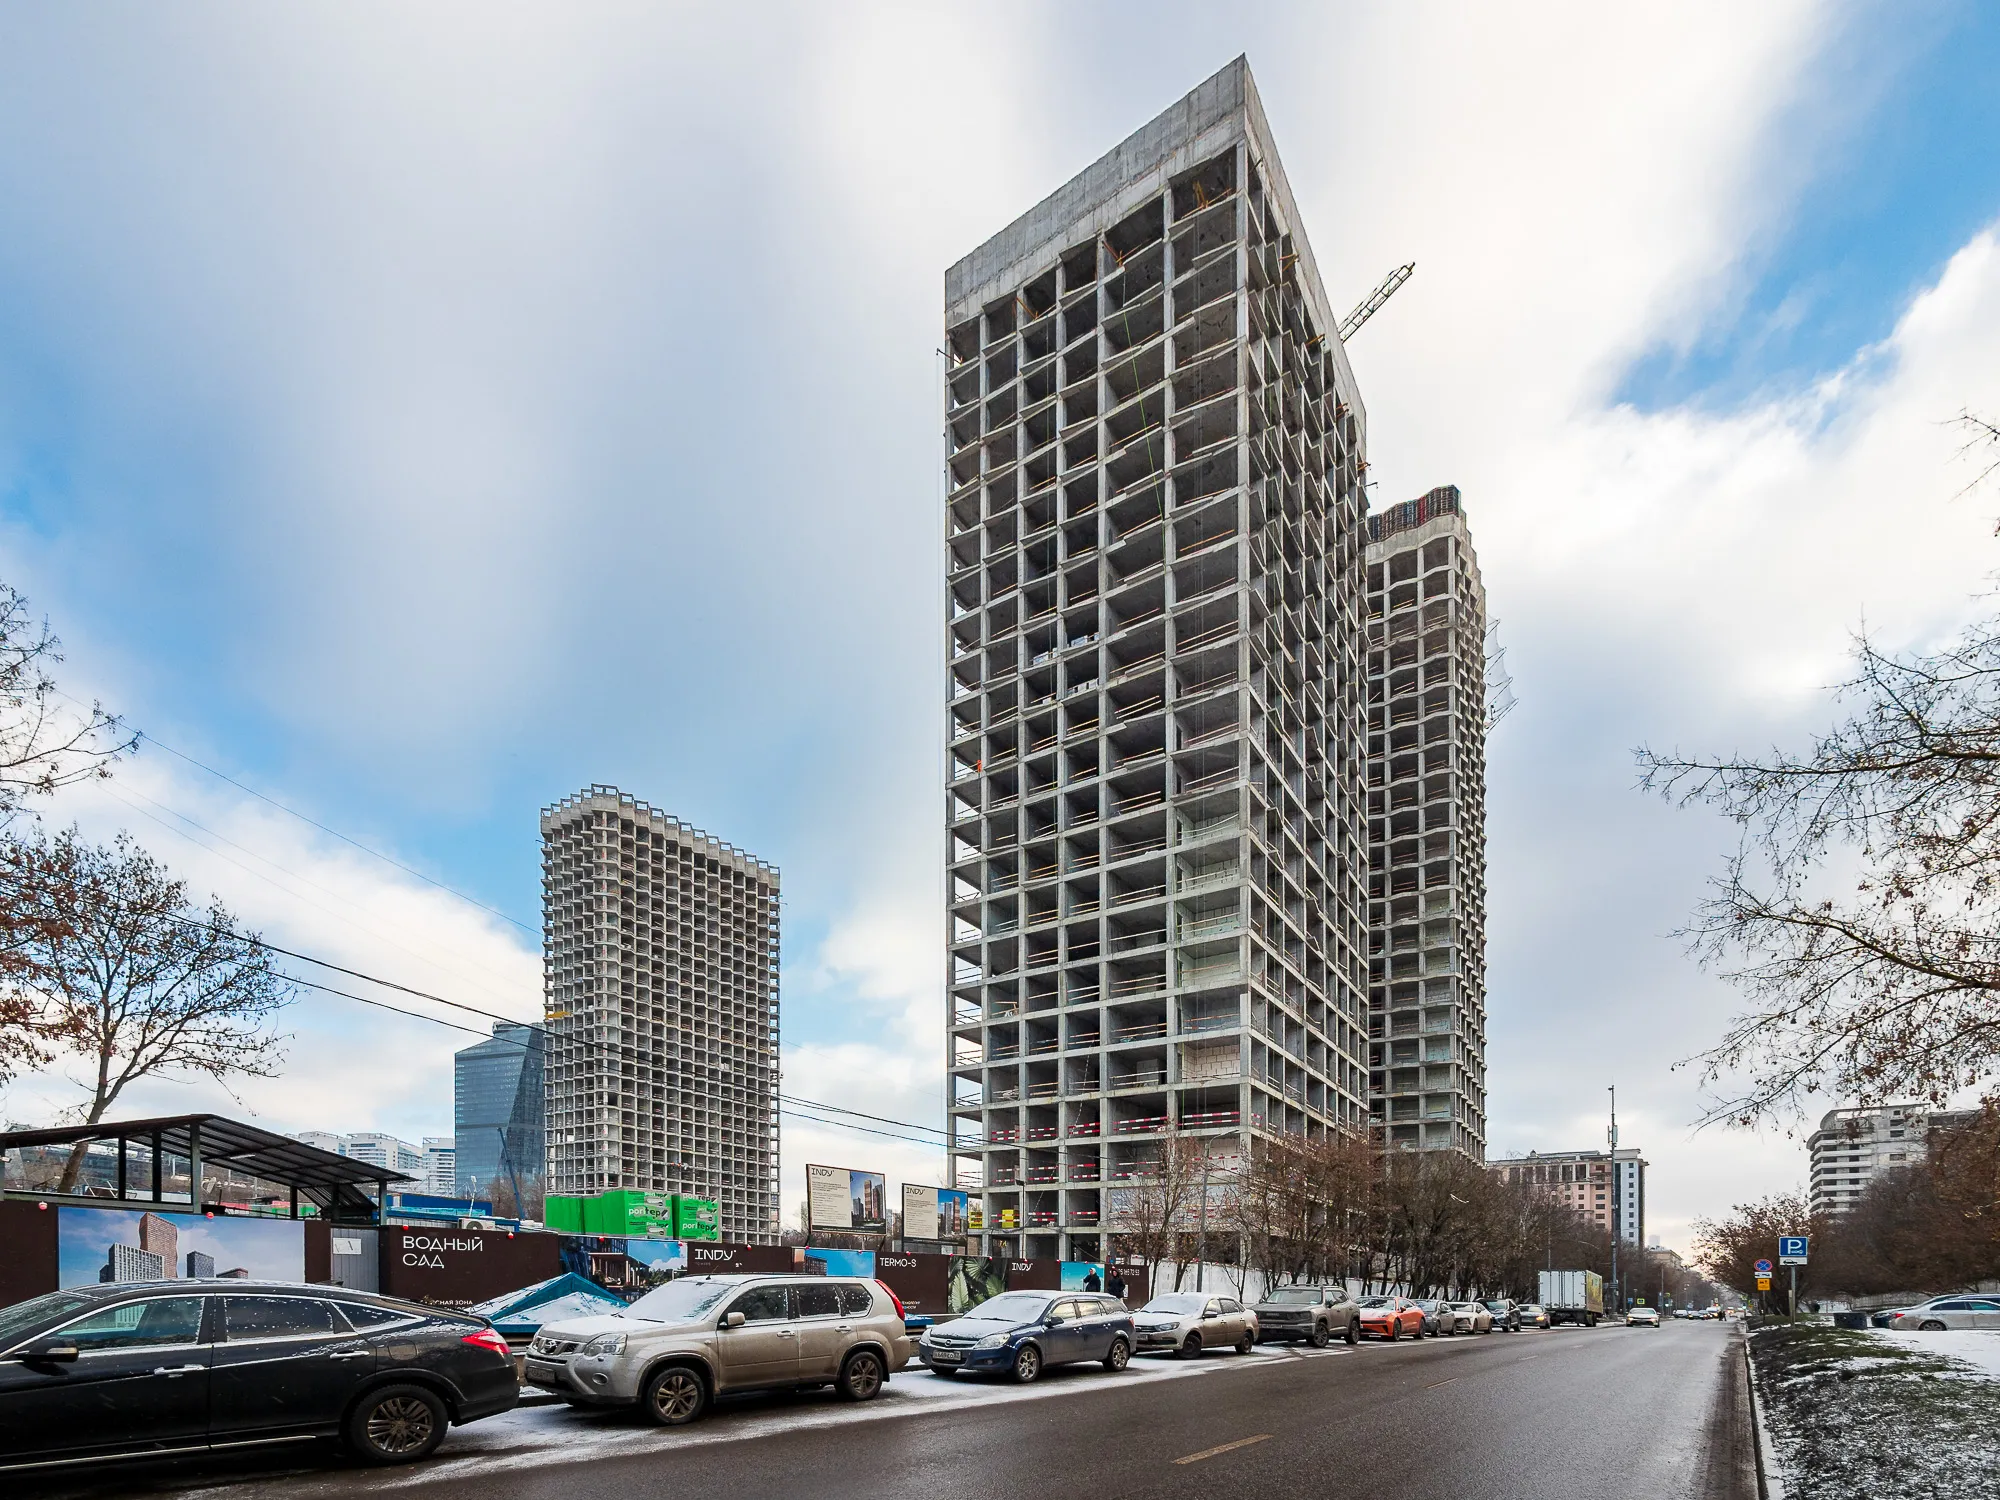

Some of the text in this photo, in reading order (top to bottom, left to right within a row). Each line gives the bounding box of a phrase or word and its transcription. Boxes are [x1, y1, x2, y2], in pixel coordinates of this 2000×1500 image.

[811, 1167, 834, 1177] INDY
[906, 1186, 925, 1196] INDY
[628, 1206, 661, 1217] poritep
[682, 1222, 711, 1231] poritep
[402, 1235, 483, 1252] ВОДНЫЙ
[1787, 1239, 1802, 1254] P
[694, 1248, 734, 1261] INDY
[402, 1253, 445, 1269] САД
[879, 1257, 917, 1268] TERMO-S
[1011, 1262, 1032, 1272] INDY
